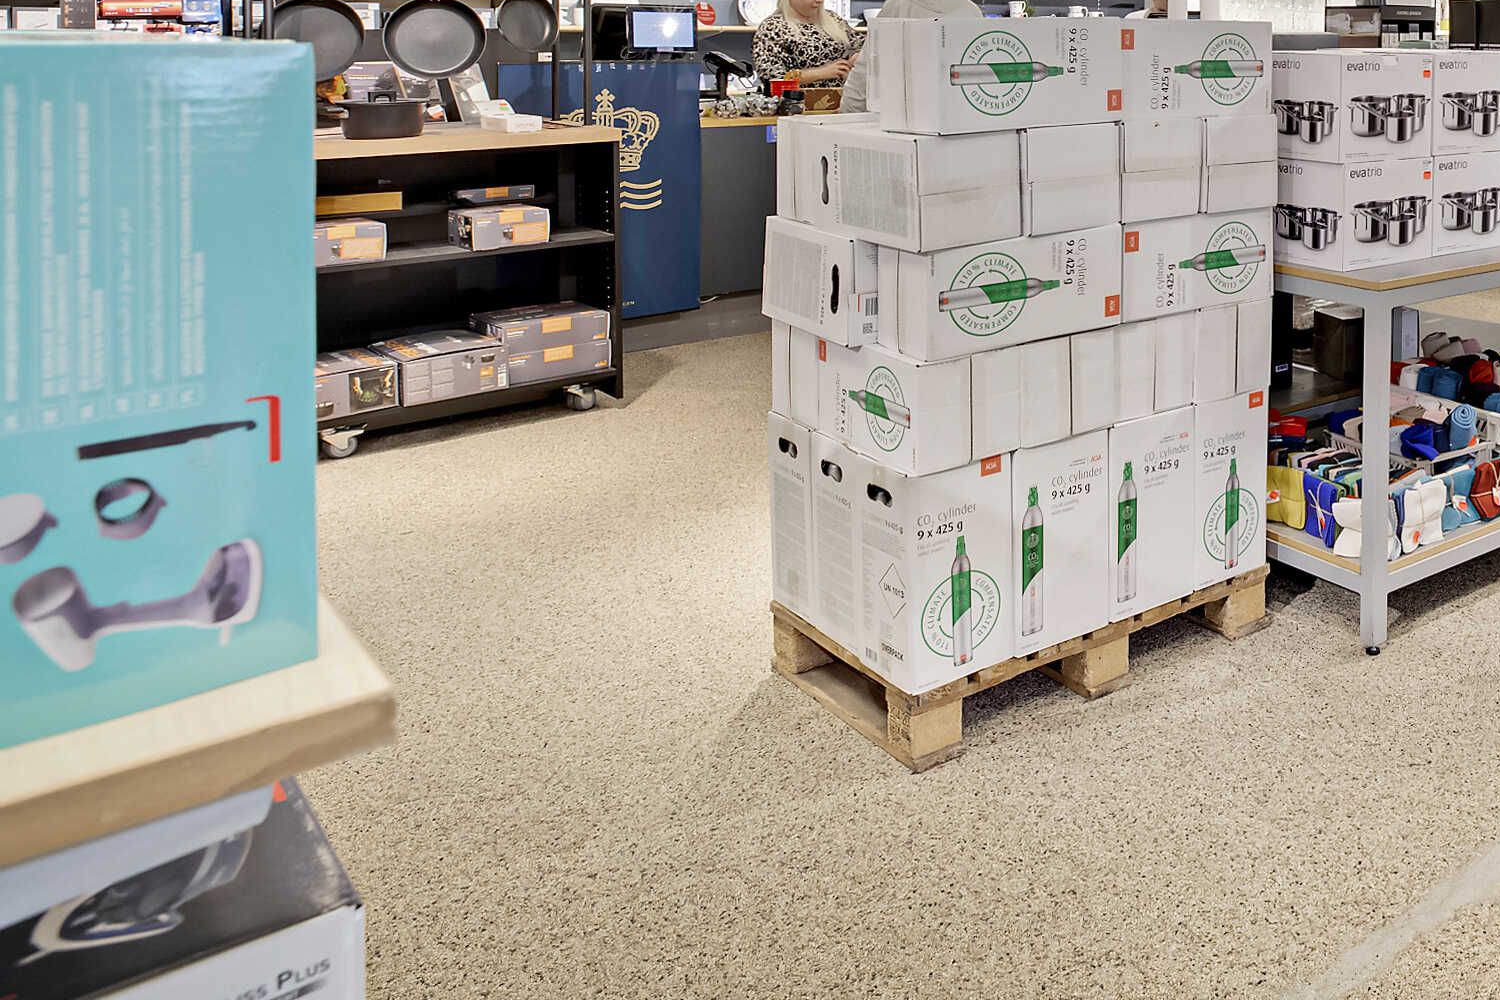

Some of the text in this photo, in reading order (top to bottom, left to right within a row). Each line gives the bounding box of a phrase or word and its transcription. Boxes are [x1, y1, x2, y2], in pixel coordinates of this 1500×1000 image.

[1068, 46, 1077, 65] 425
[1079, 47, 1089, 87] cylinder
[1272, 59, 1301, 71] evatrio
[1346, 60, 1381, 73] evatrio
[1439, 59, 1468, 71] evatrio
[1151, 54, 1160, 95] cylinder
[1161, 76, 1169, 94] 425
[1349, 165, 1383, 180] evatrio
[1438, 159, 1468, 171] evatrio
[1066, 239, 1075, 247] 9
[1065, 257, 1075, 276] 425
[1156, 252, 1165, 290] cylinder
[1077, 257, 1088, 297] cylinder
[1167, 272, 1175, 291] 425
[959, 304, 1017, 331] COMPENSATED
[1217, 429, 1247, 445] cylinder
[1159, 443, 1190, 460] cylinder
[1203, 445, 1236, 459] 9 x 425 g
[1068, 466, 1103, 485] cylinder
[1143, 459, 1180, 474] 9 x 425 g
[1051, 482, 1091, 499] 9 x 425 g
[937, 503, 977, 525] cylinder
[917, 520, 963, 541] 9 x 425 g
[975, 577, 996, 638] COMPENSATED
